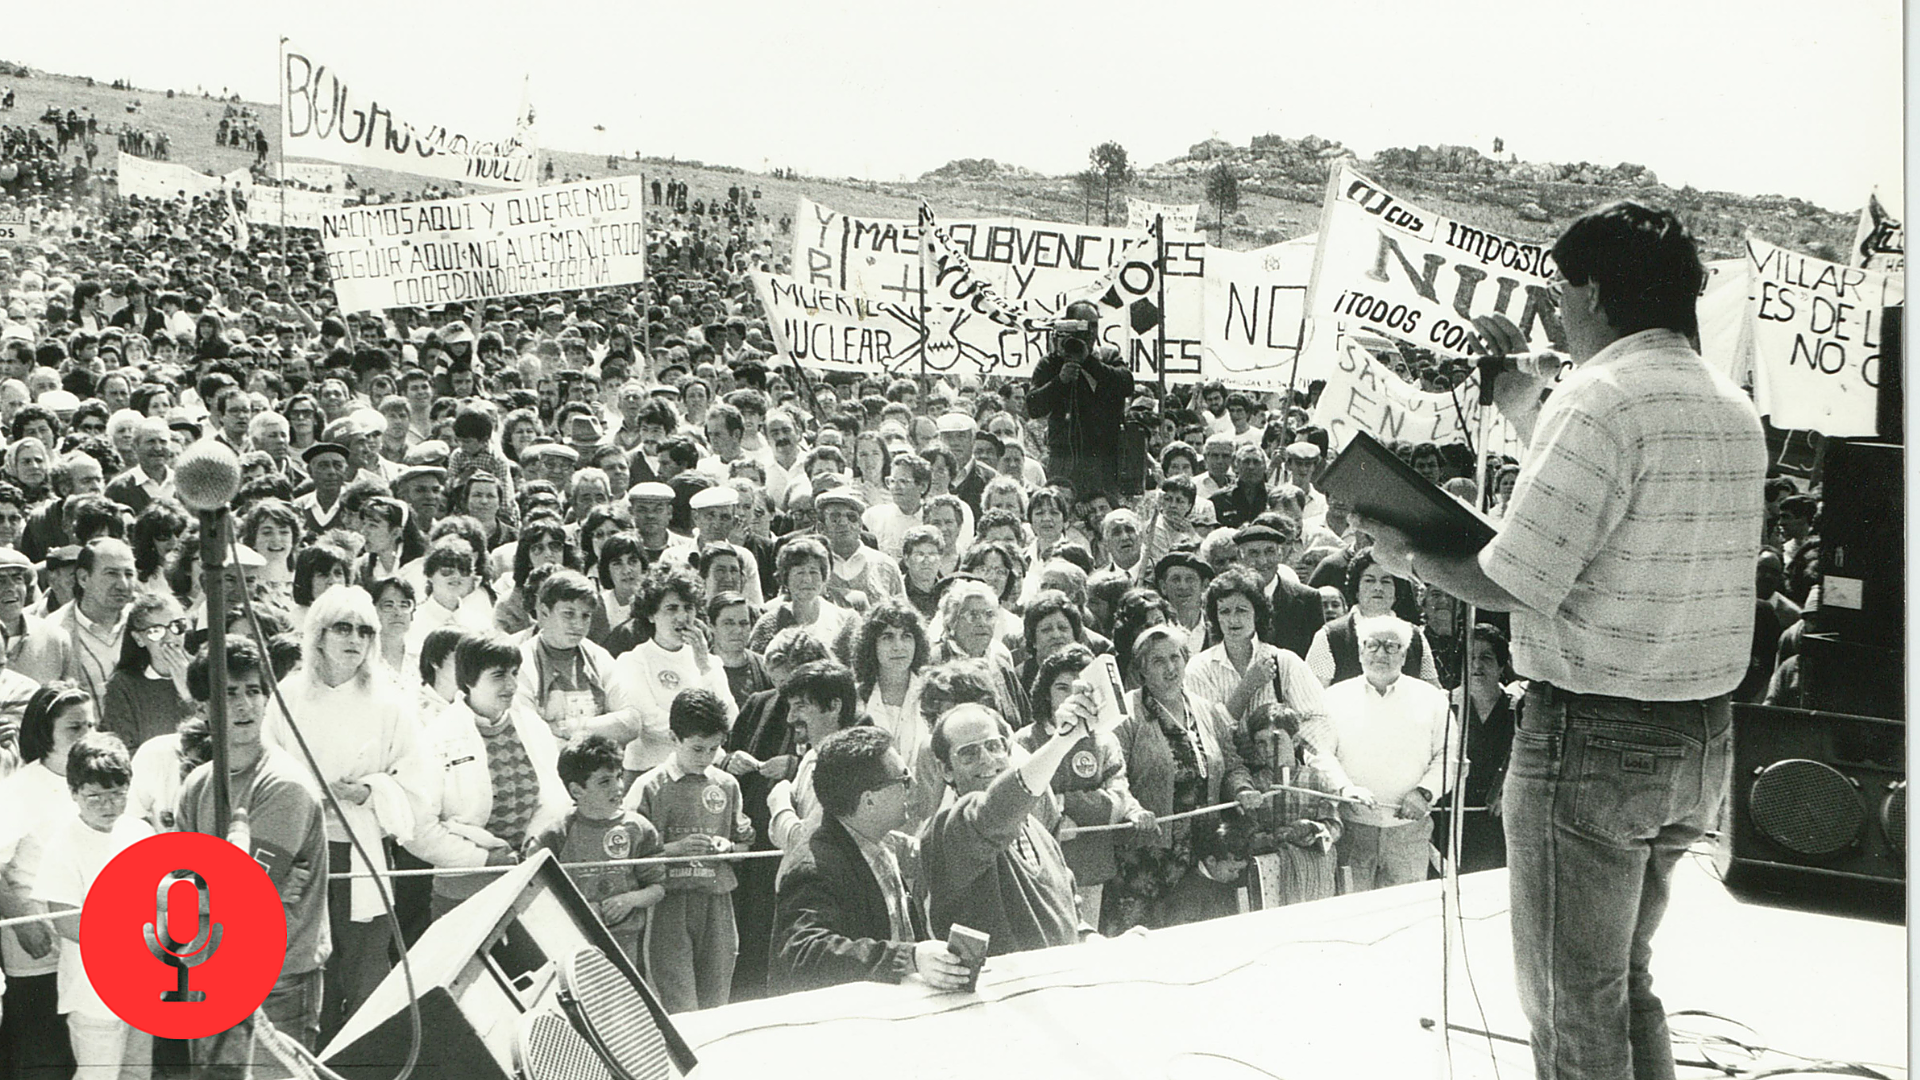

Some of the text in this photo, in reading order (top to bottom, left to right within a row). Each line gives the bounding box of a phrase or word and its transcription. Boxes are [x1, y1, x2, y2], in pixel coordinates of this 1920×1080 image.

[322, 206, 414, 239] NACIMOS
[417, 203, 475, 232] AQUI
[480, 202, 495, 229] Y
[507, 181, 631, 226] QUEREMOS
[327, 246, 403, 281] SEGUIR
[468, 240, 499, 269] NO
[530, 222, 641, 263] CEMENTERIO
[1746, 240, 1867, 301] VILLAR
[394, 264, 540, 305] COORDINADORA
[1226, 282, 1308, 350] NO
[1810, 296, 1855, 341] DE
[1790, 332, 1845, 375] NO
